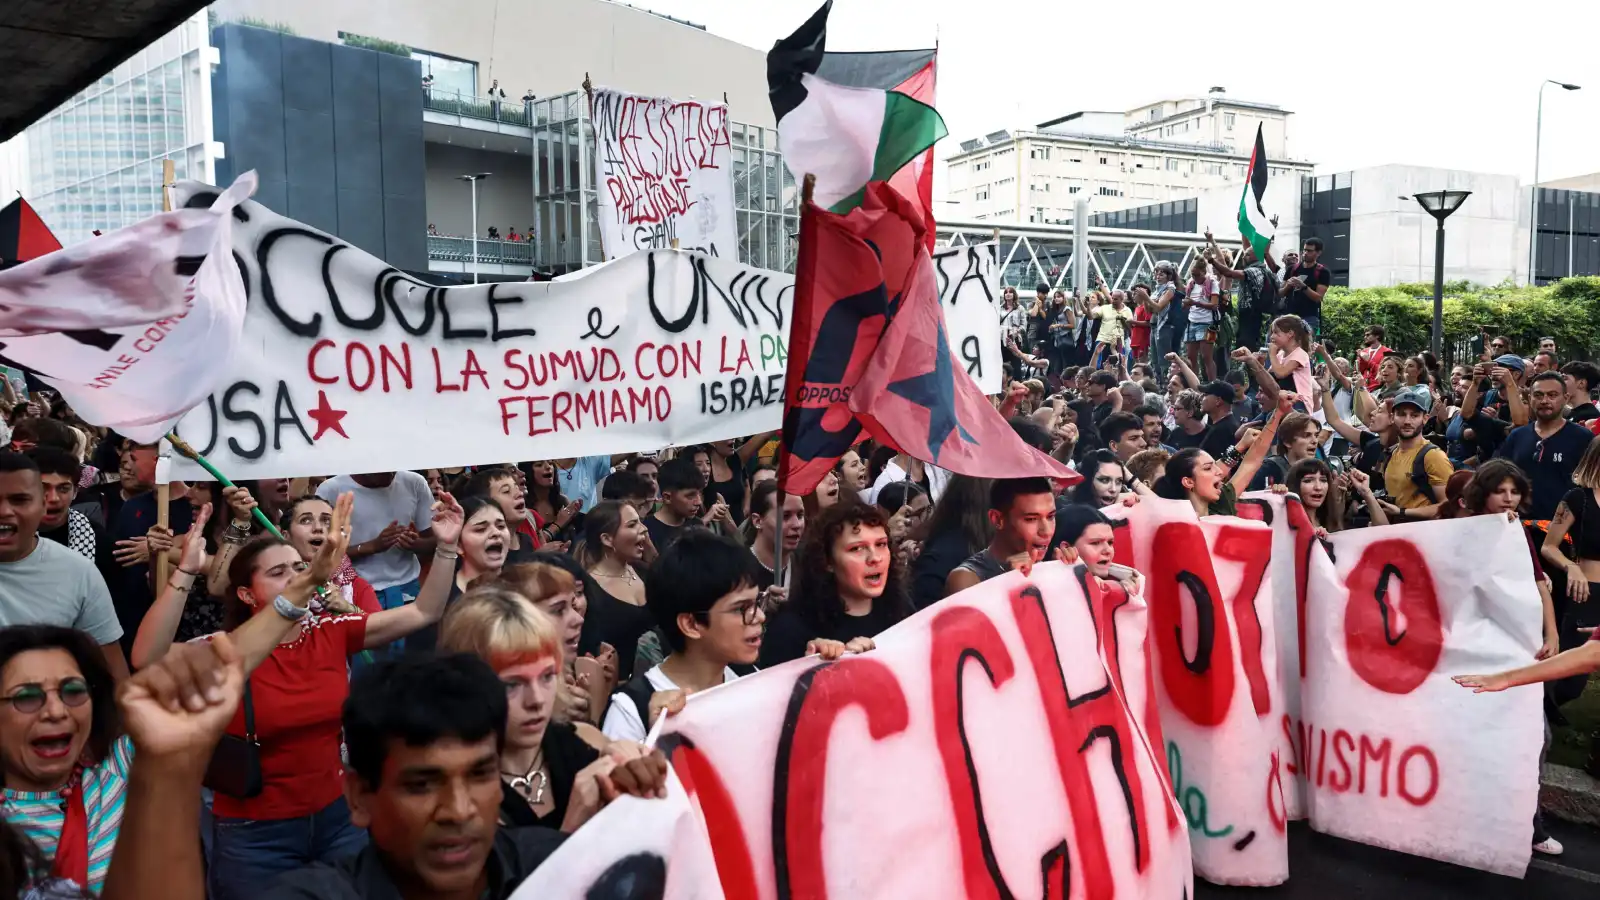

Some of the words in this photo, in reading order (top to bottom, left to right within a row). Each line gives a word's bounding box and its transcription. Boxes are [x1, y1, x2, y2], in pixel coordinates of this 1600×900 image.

[580, 306, 620, 340] e
[307, 338, 413, 393] CON
[431, 347, 490, 394] LA
[504, 346, 626, 391] SUMUD,
[635, 338, 702, 381] CON
[718, 335, 754, 376] LA
[498, 384, 672, 437] FERMIAMO
[797, 385, 852, 403] OPPOS
